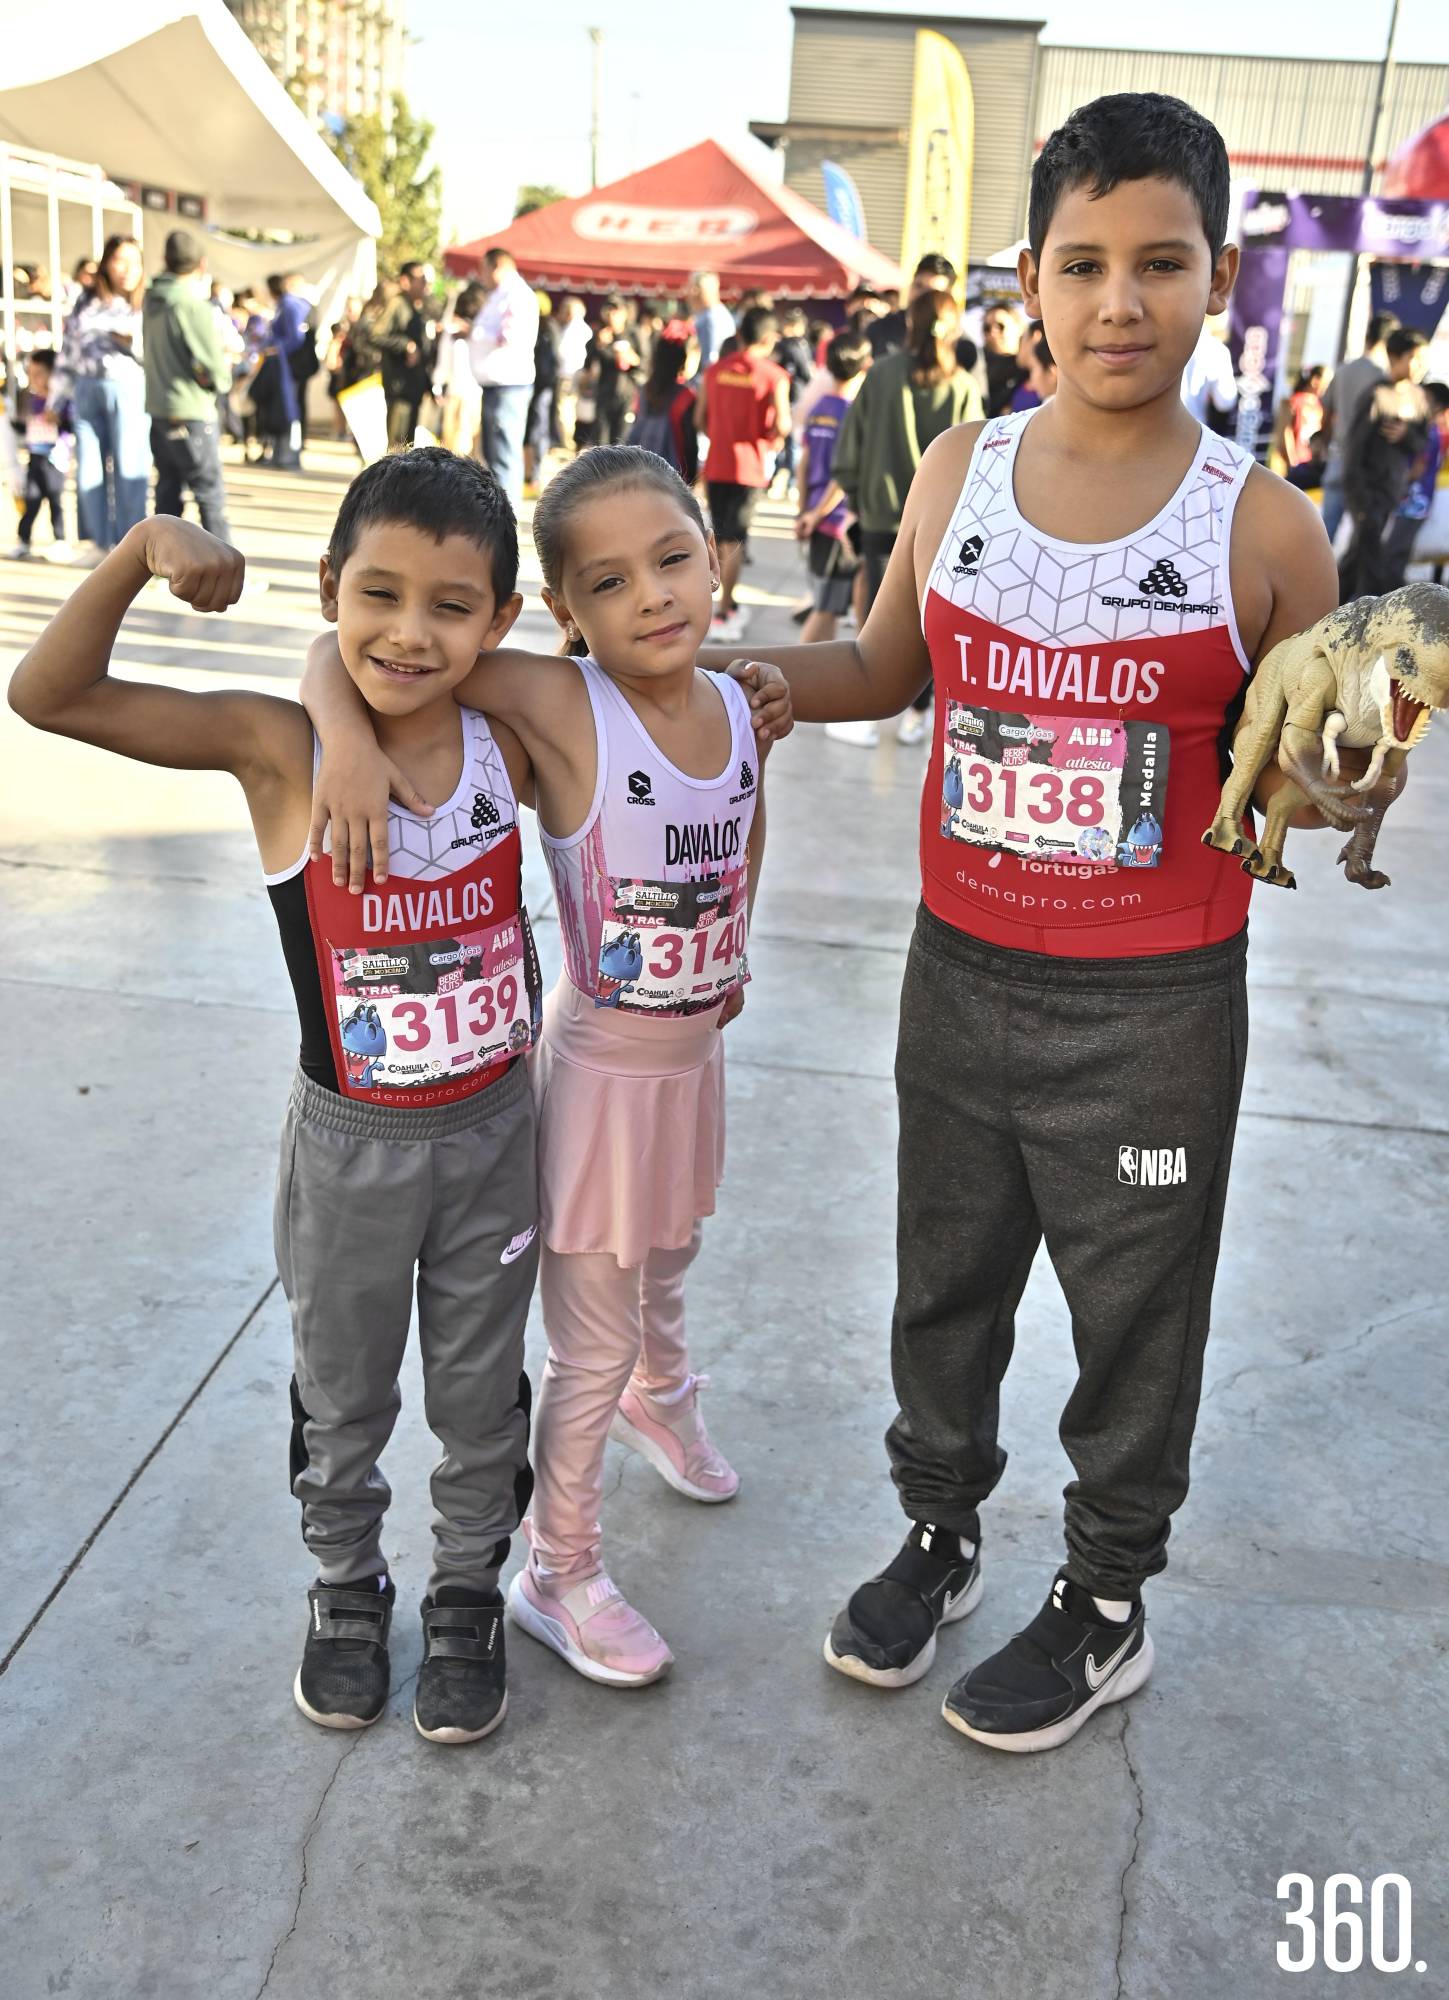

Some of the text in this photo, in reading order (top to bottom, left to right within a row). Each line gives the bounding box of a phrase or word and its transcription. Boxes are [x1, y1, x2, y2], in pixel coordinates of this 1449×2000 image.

[1101, 595, 1220, 616] GRUPO DEMAPRO
[953, 633, 1165, 705] T. DAVALOS
[1000, 725, 1054, 739] Cargo Gas
[1067, 726, 1113, 747] ABB
[1002, 755, 1024, 766] NUTS
[1003, 747, 1029, 758] BERRY
[1065, 756, 1112, 771] atlesia
[1138, 731, 1158, 807] Medalla
[626, 795, 656, 807] CROSS
[967, 763, 1105, 827] 3138
[450, 820, 518, 850] GRUPO DEMAPRO
[961, 818, 989, 833] COAHUILA
[665, 816, 742, 866] DAVALOS
[1017, 857, 1120, 880] Tortugas
[635, 891, 679, 902] SALTILLO
[956, 869, 1142, 910] demapro.com
[361, 876, 495, 934] DAVALOS
[491, 926, 516, 953] ABB
[648, 911, 747, 980] 3140
[362, 957, 409, 969] SALTILLO
[431, 946, 482, 965] Cargo Gas
[438, 968, 464, 986] BERRY
[437, 981, 461, 996] NUTS
[636, 986, 675, 997] COAHUILA
[391, 974, 519, 1053] 3139
[387, 1062, 430, 1074] COAHUILA
[371, 1069, 491, 1103] demapro.com
[1139, 1146, 1188, 1186] NBA
